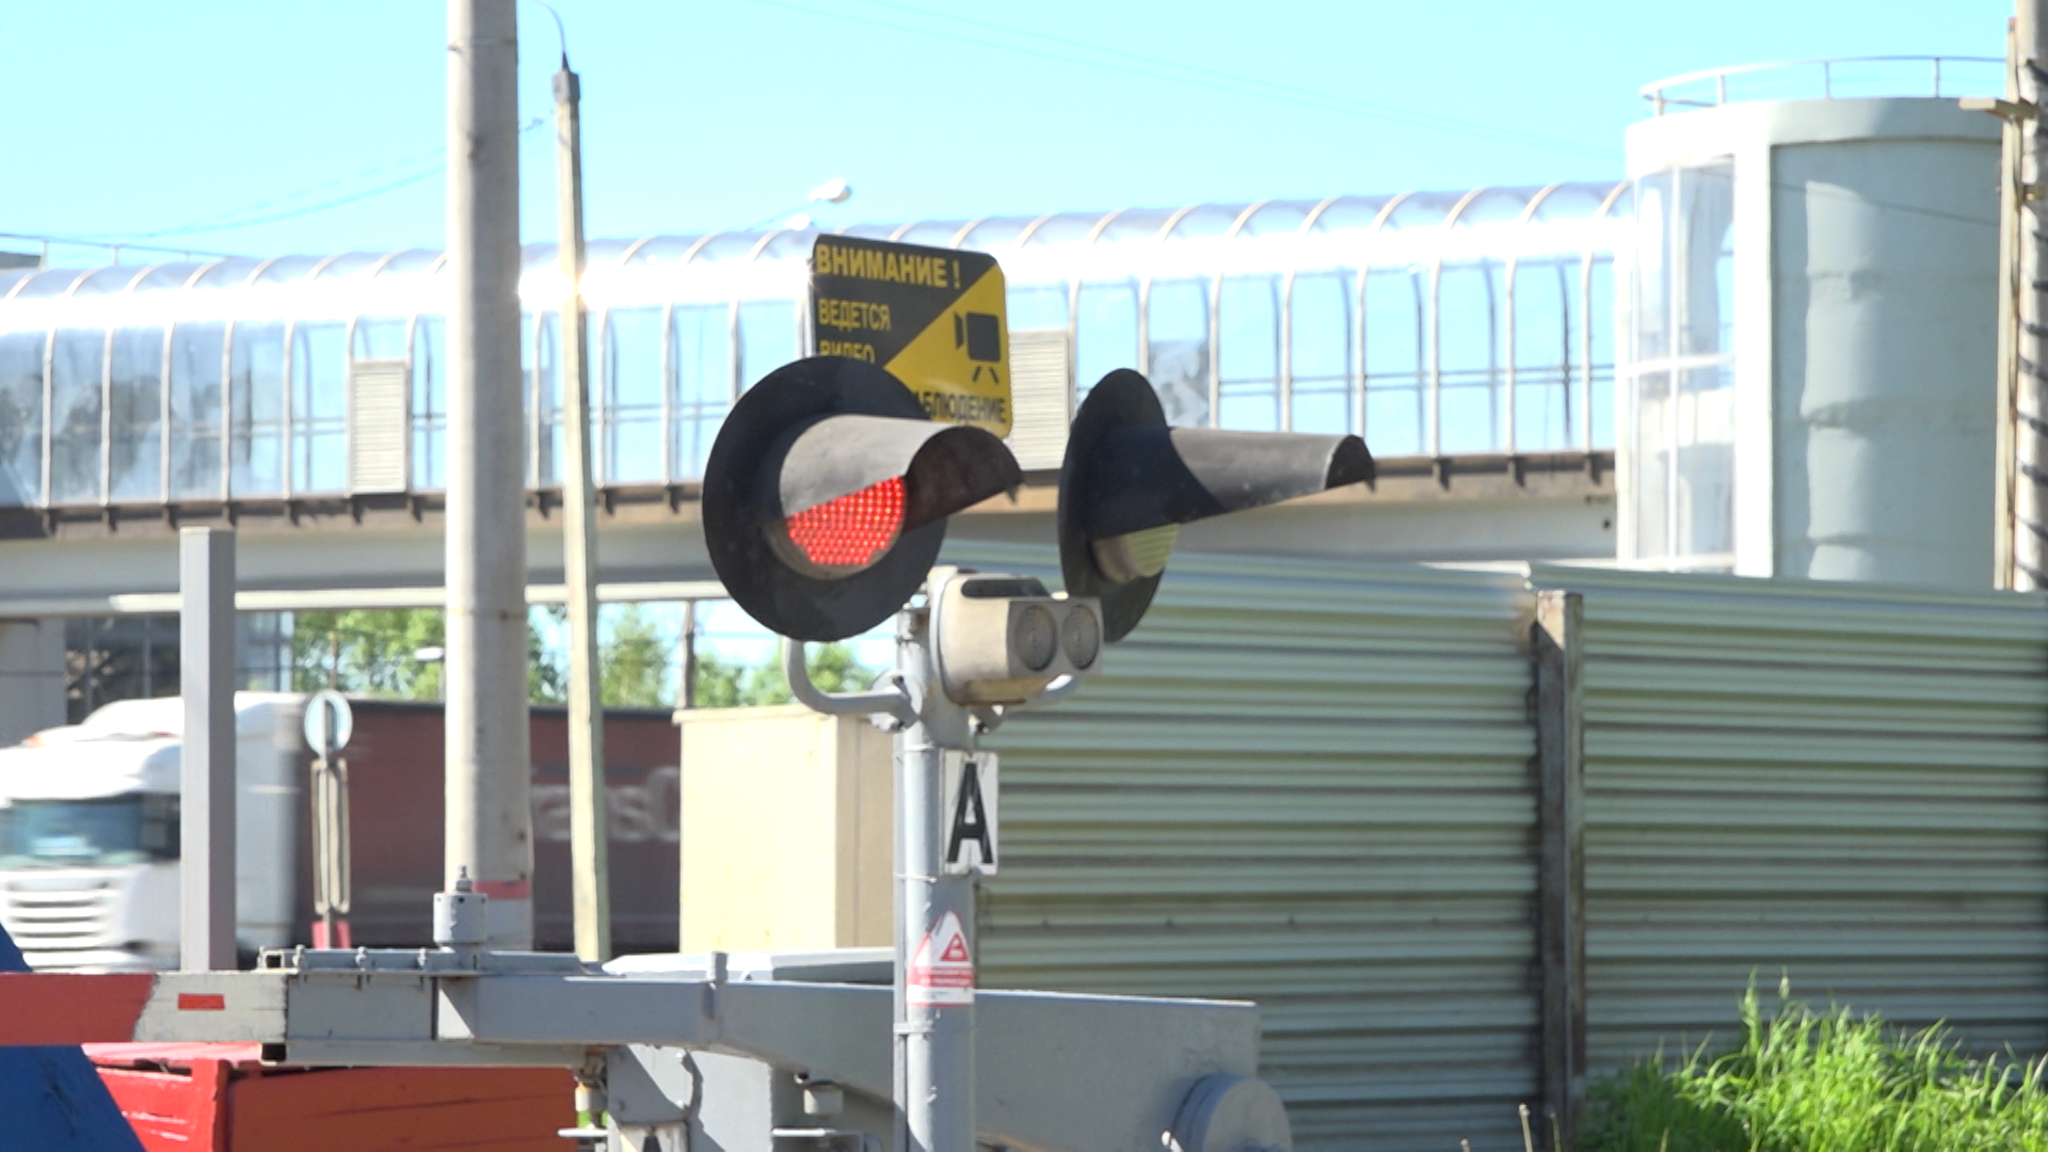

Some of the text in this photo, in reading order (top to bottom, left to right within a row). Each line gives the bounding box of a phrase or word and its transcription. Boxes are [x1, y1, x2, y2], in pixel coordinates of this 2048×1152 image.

[816, 245, 947, 288] ВНИМАНИЕ
[819, 298, 891, 332] ВЕДЕТСЯ
[918, 391, 1006, 425] БЛЮДЕНИЕ
